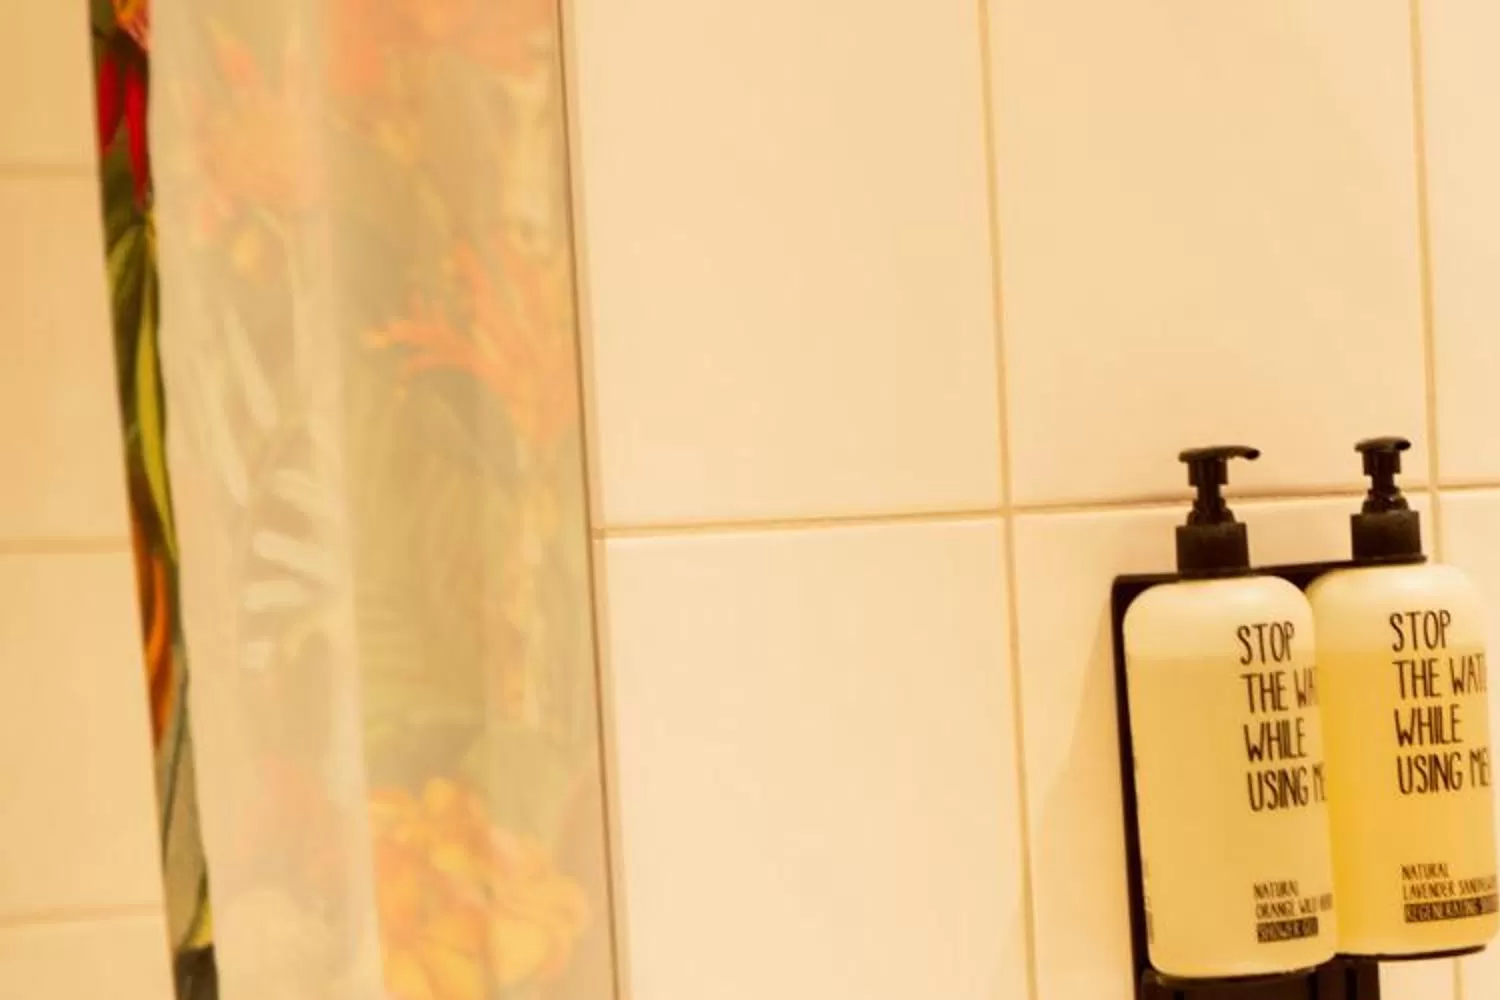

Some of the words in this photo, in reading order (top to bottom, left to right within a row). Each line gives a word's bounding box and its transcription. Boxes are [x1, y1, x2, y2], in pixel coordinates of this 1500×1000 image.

[1237, 621, 1294, 665] STOP
[1389, 609, 1451, 652] STOP
[1240, 671, 1289, 713] THE
[1392, 658, 1442, 699] THE
[1244, 717, 1307, 762] WHILE
[1394, 703, 1463, 747] WHILE
[1247, 766, 1309, 812] USING
[1396, 751, 1463, 795] USING
